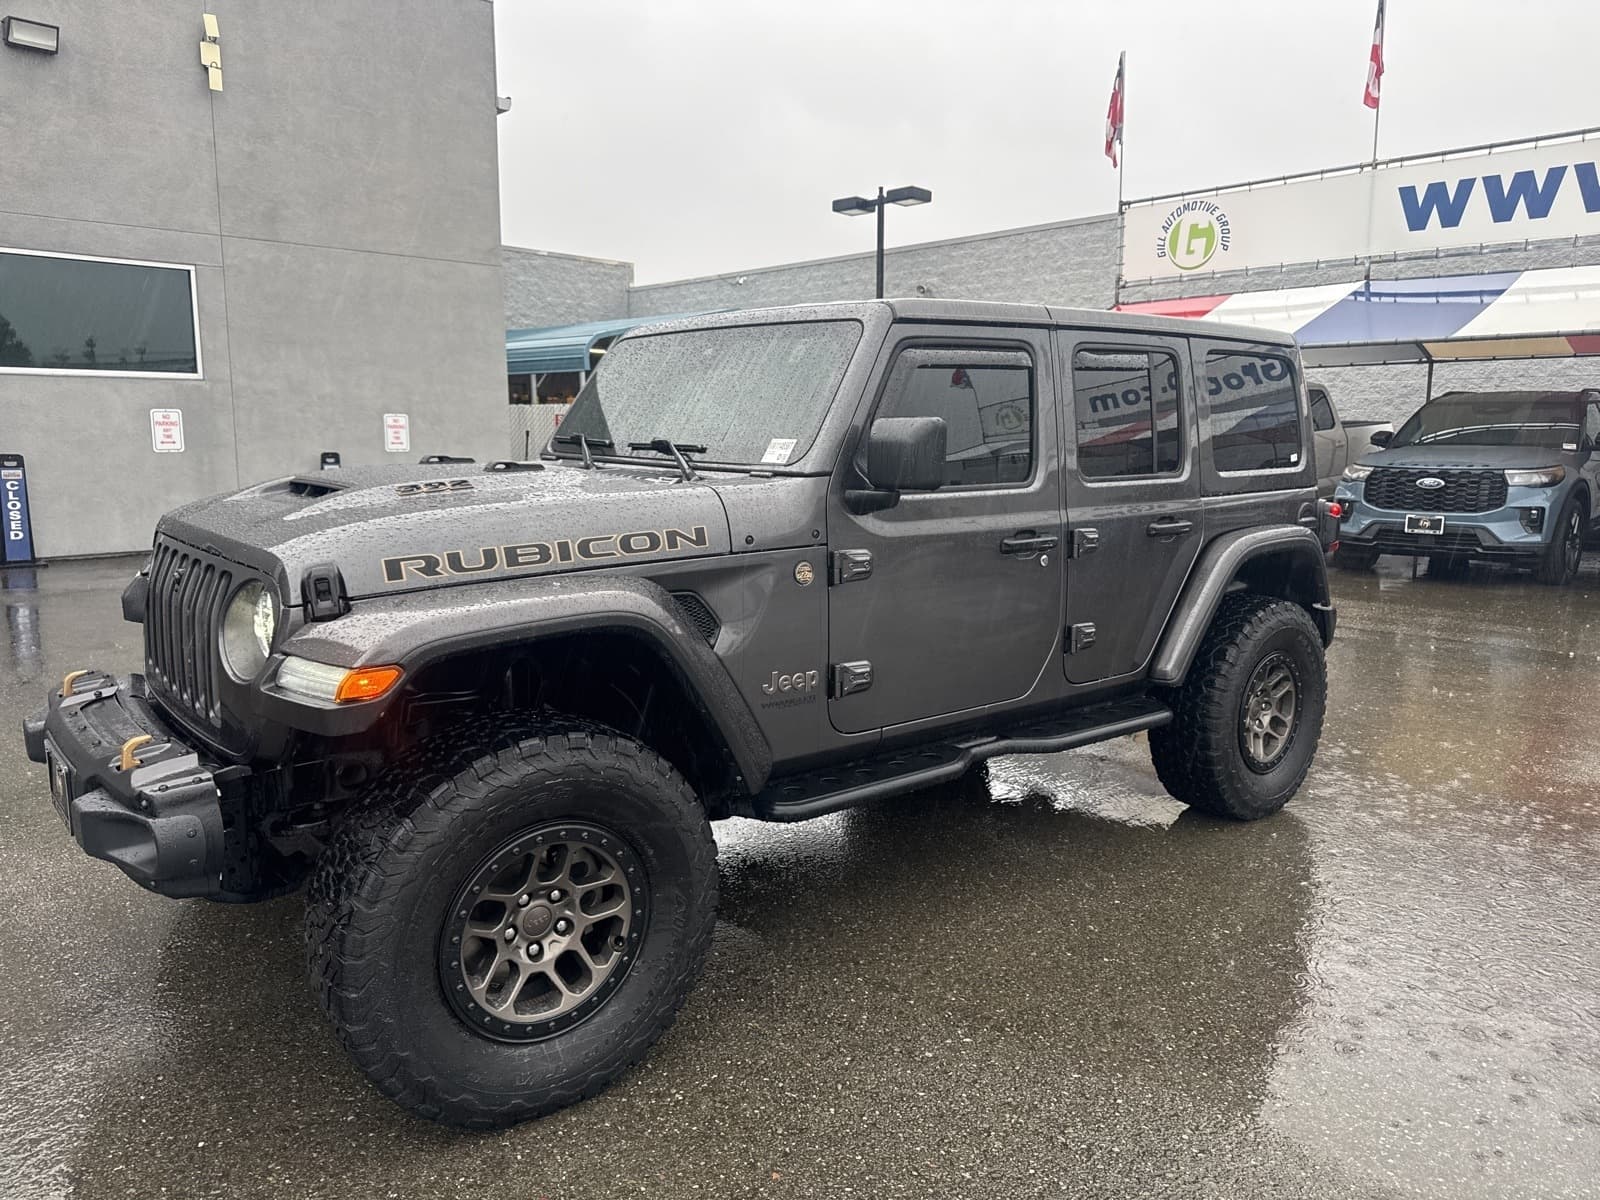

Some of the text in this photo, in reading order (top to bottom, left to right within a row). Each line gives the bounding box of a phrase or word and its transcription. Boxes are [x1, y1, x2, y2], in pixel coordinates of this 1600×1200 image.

[1156, 201, 1231, 258] GILL AUTOMOTIVE GROUP
[5, 481, 24, 540] CLOSED
[381, 525, 708, 583] RUBICON
[761, 669, 819, 695] Jeep
